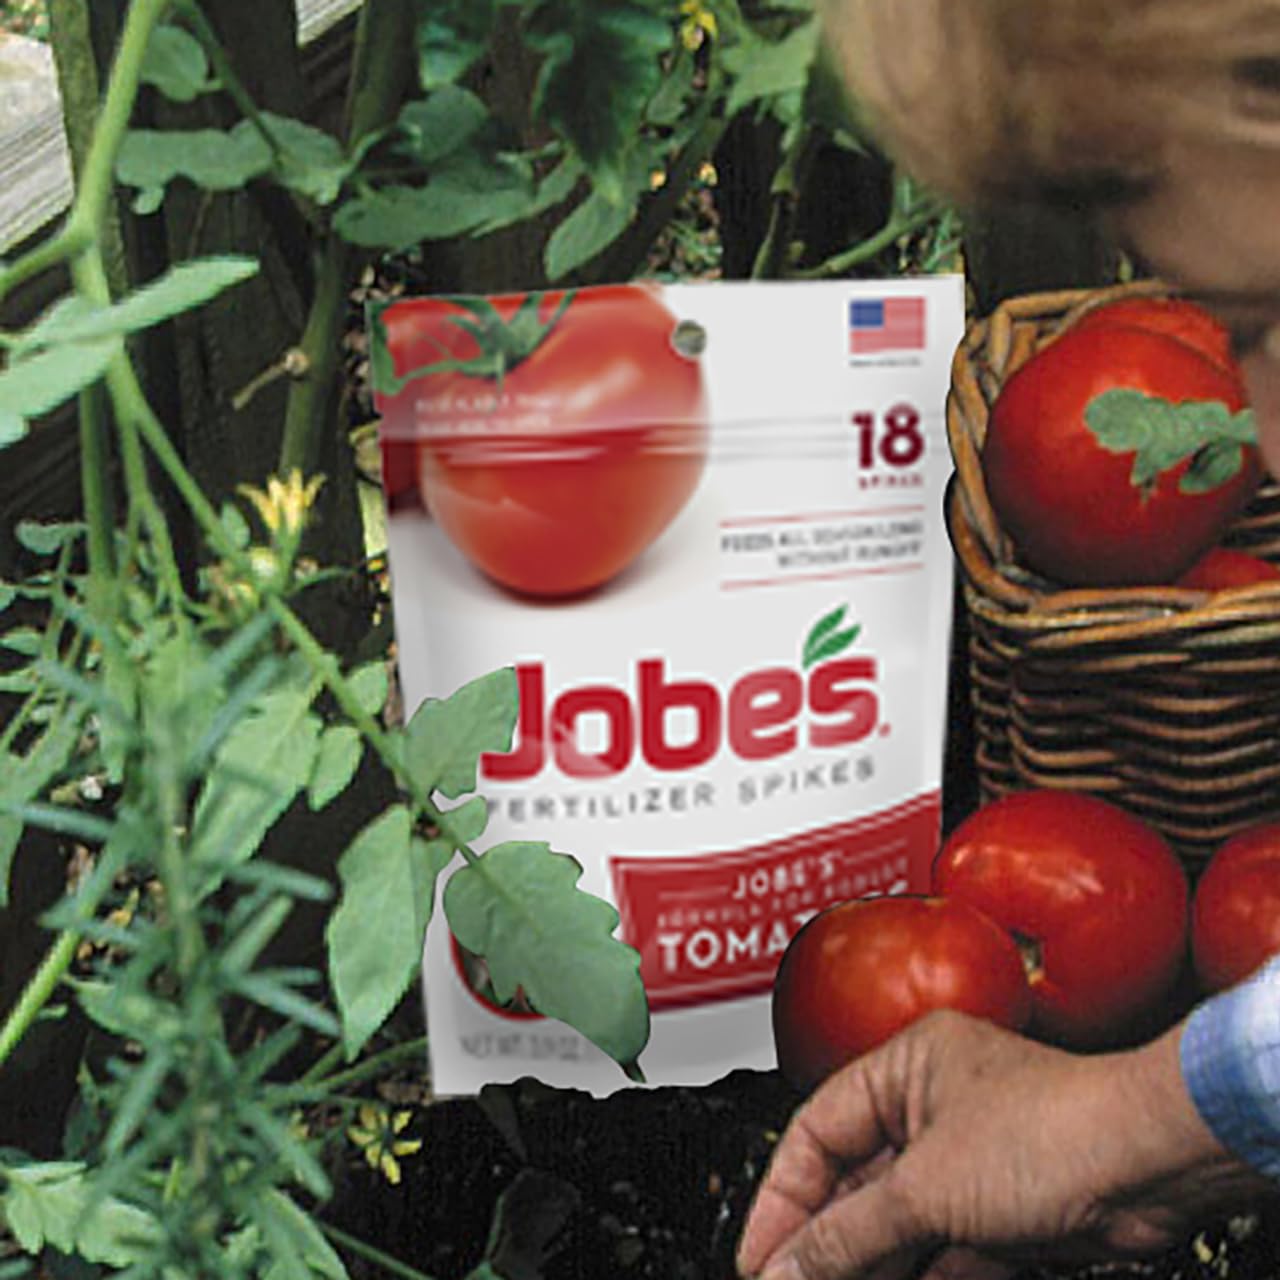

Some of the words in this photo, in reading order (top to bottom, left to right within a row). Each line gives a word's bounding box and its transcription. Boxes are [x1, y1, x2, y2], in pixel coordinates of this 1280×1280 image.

[851, 402, 926, 469] 18
[484, 784, 715, 823] FERTILIZER
[738, 755, 875, 805] SPIKES
